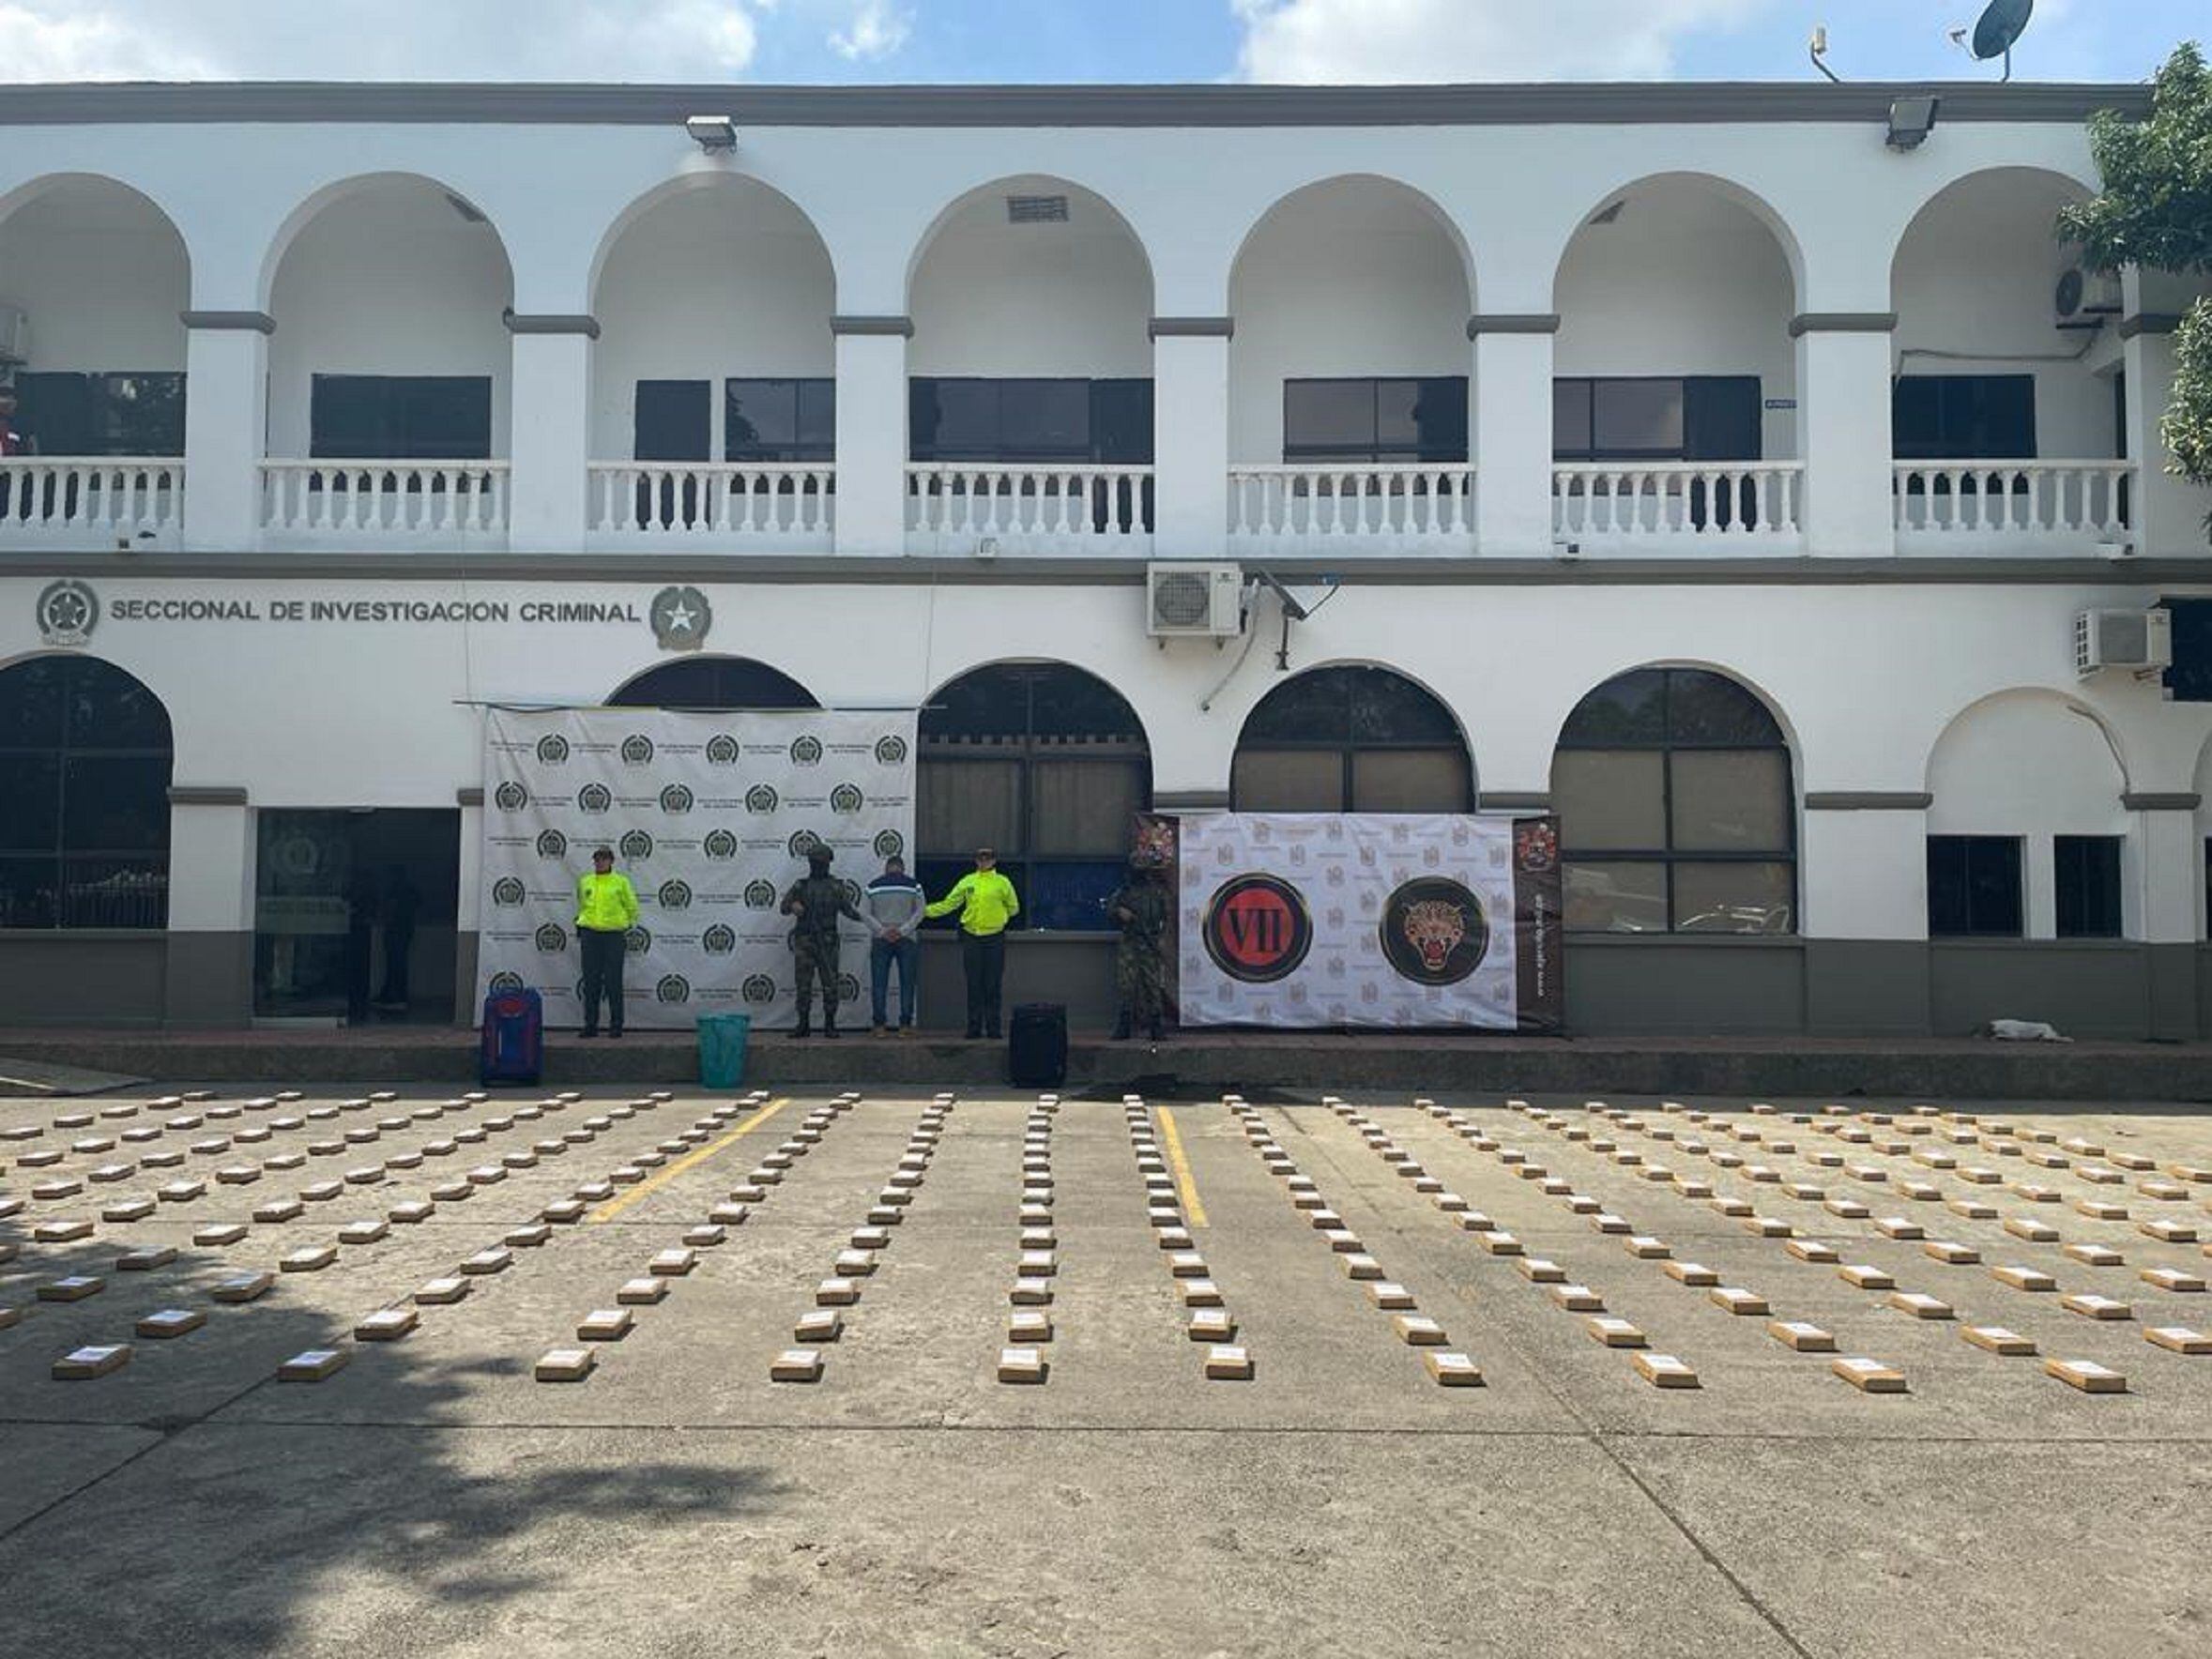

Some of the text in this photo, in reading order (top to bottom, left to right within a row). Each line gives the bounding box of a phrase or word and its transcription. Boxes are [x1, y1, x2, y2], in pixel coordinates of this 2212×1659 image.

[111, 600, 641, 621] SECCIONAL DE INVESTIGACION CRIMINAL
[1226, 907, 1284, 952] VII
